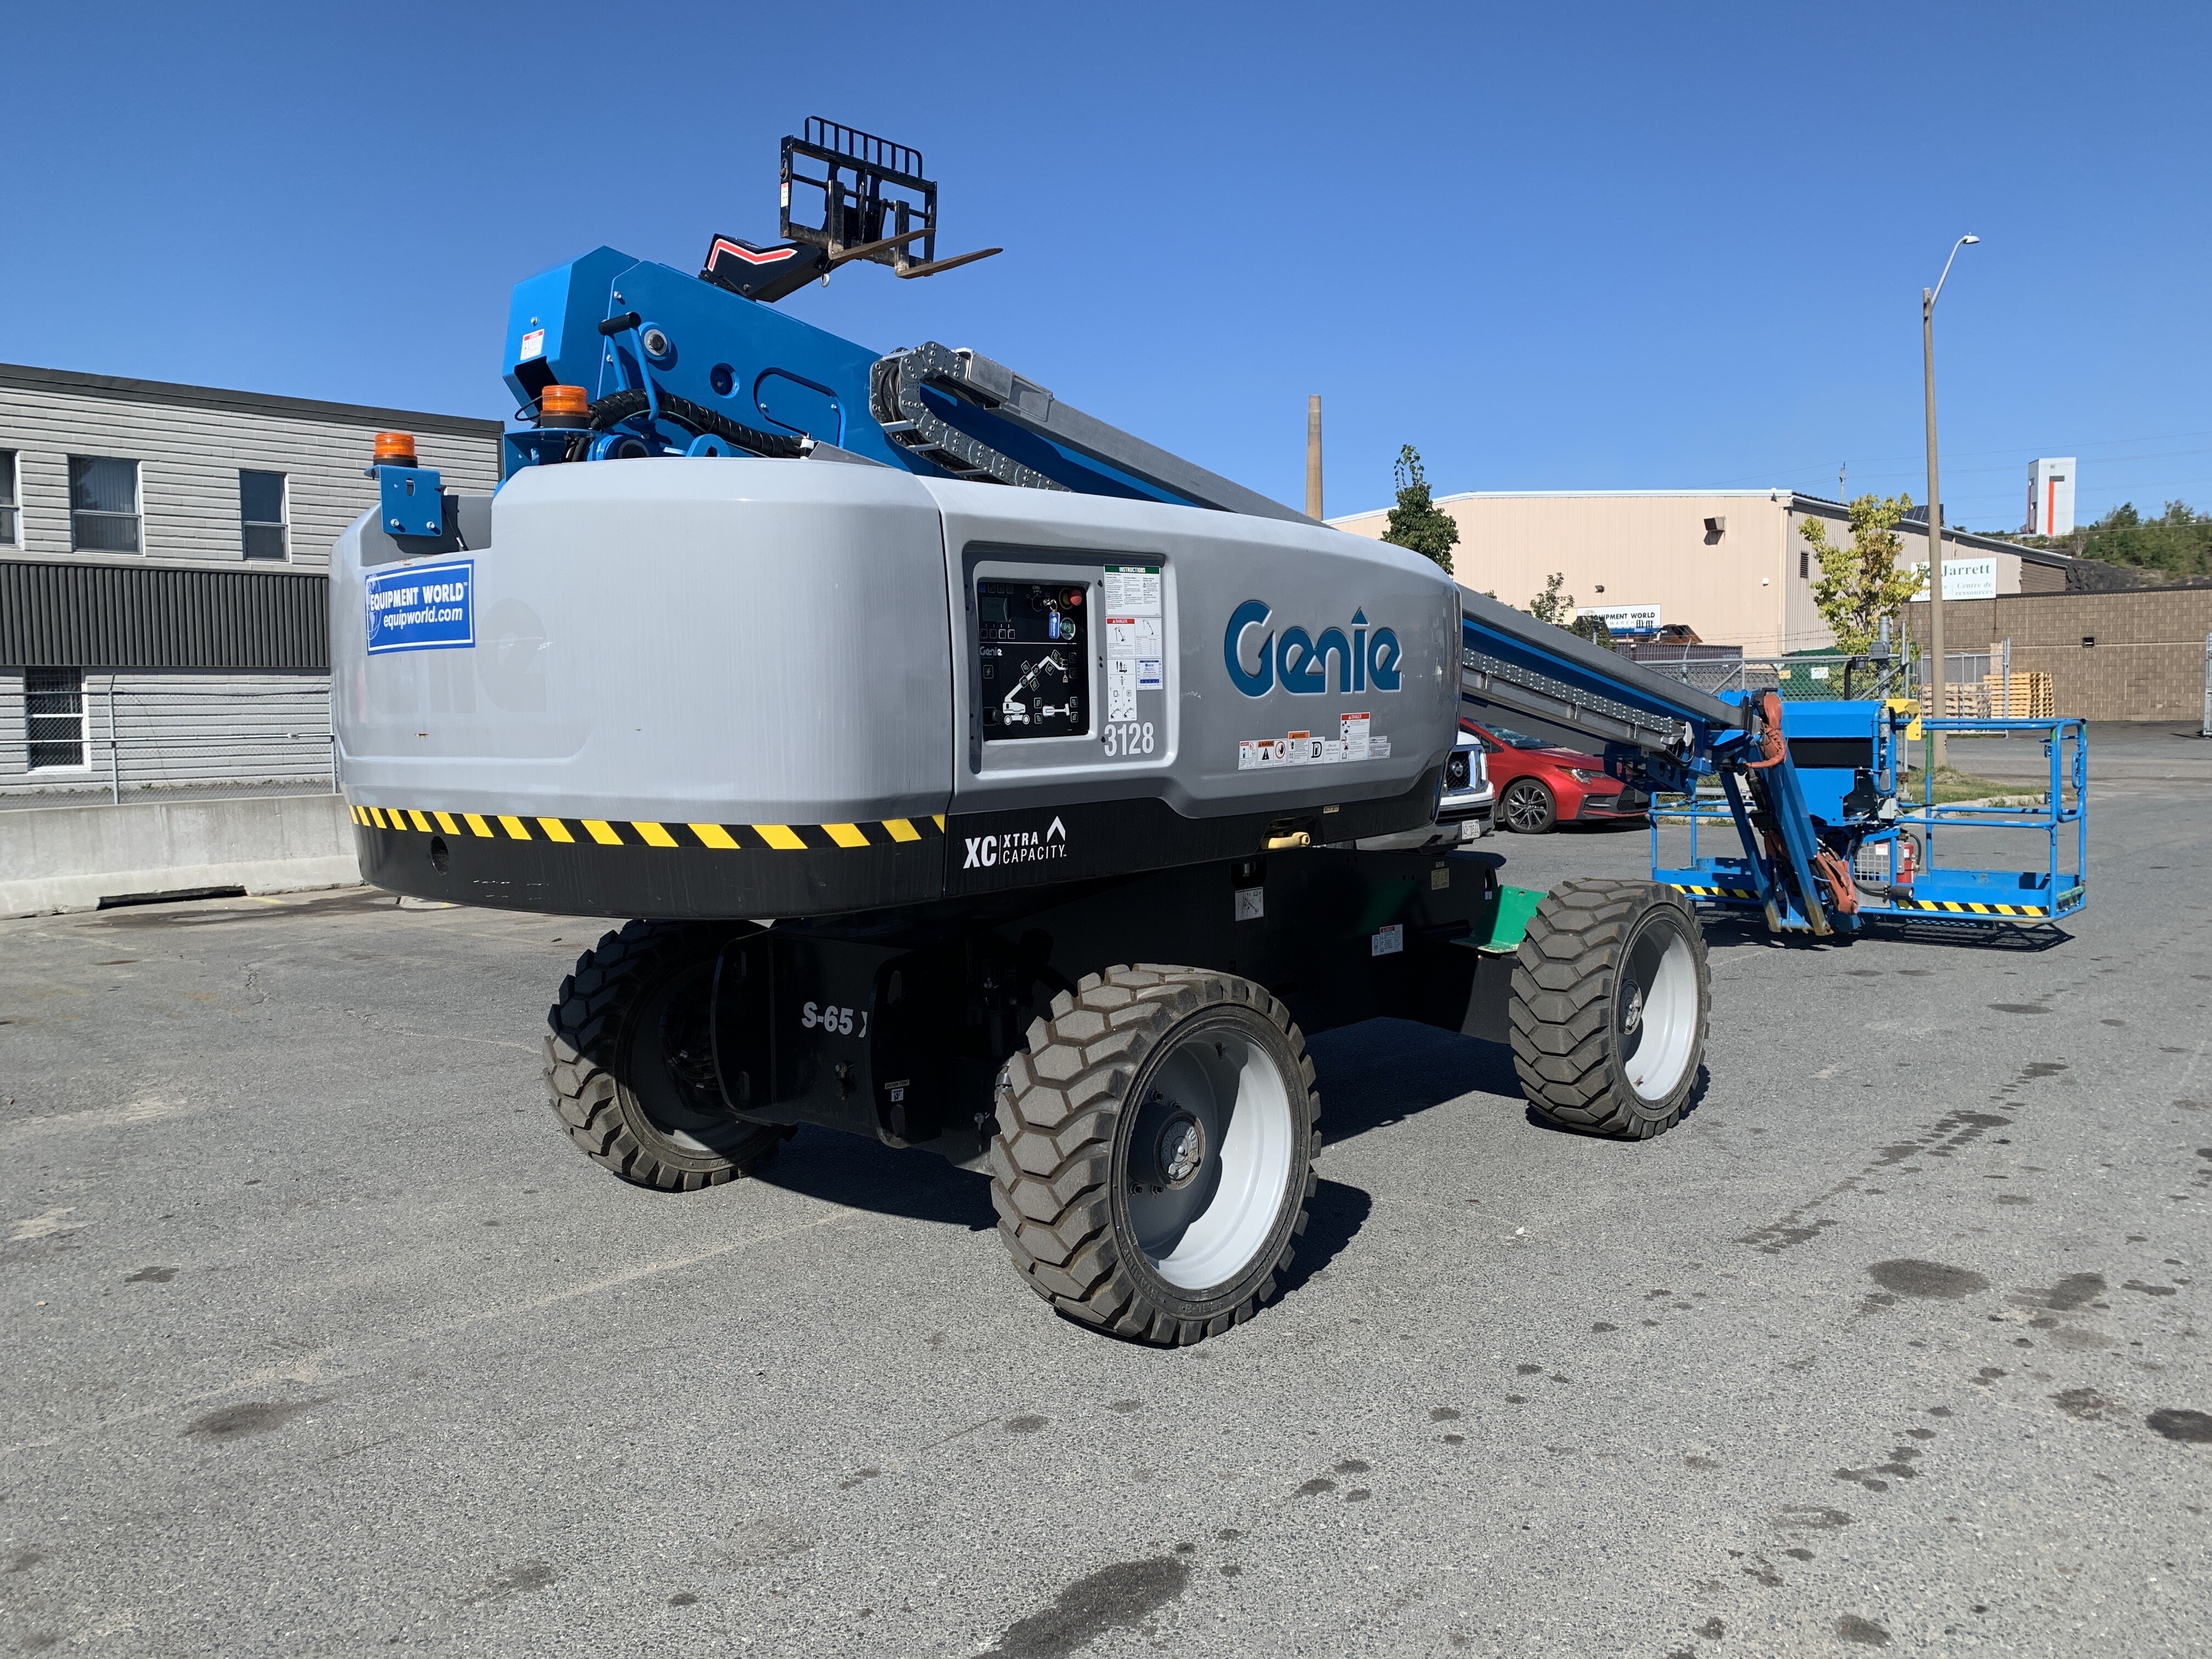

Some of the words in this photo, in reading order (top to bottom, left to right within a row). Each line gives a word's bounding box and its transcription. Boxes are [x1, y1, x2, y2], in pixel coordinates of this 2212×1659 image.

[1943, 564, 1990, 577] Jarrett
[370, 586, 419, 611] EQUIPMENT
[383, 606, 462, 630] equipworld.com
[979, 646, 1003, 657] Genie
[1224, 600, 1403, 698] Genie
[1104, 722, 1154, 757] 3128
[963, 835, 997, 869] XC
[1003, 831, 1039, 848] XTRA
[802, 1001, 854, 1035] S-65
